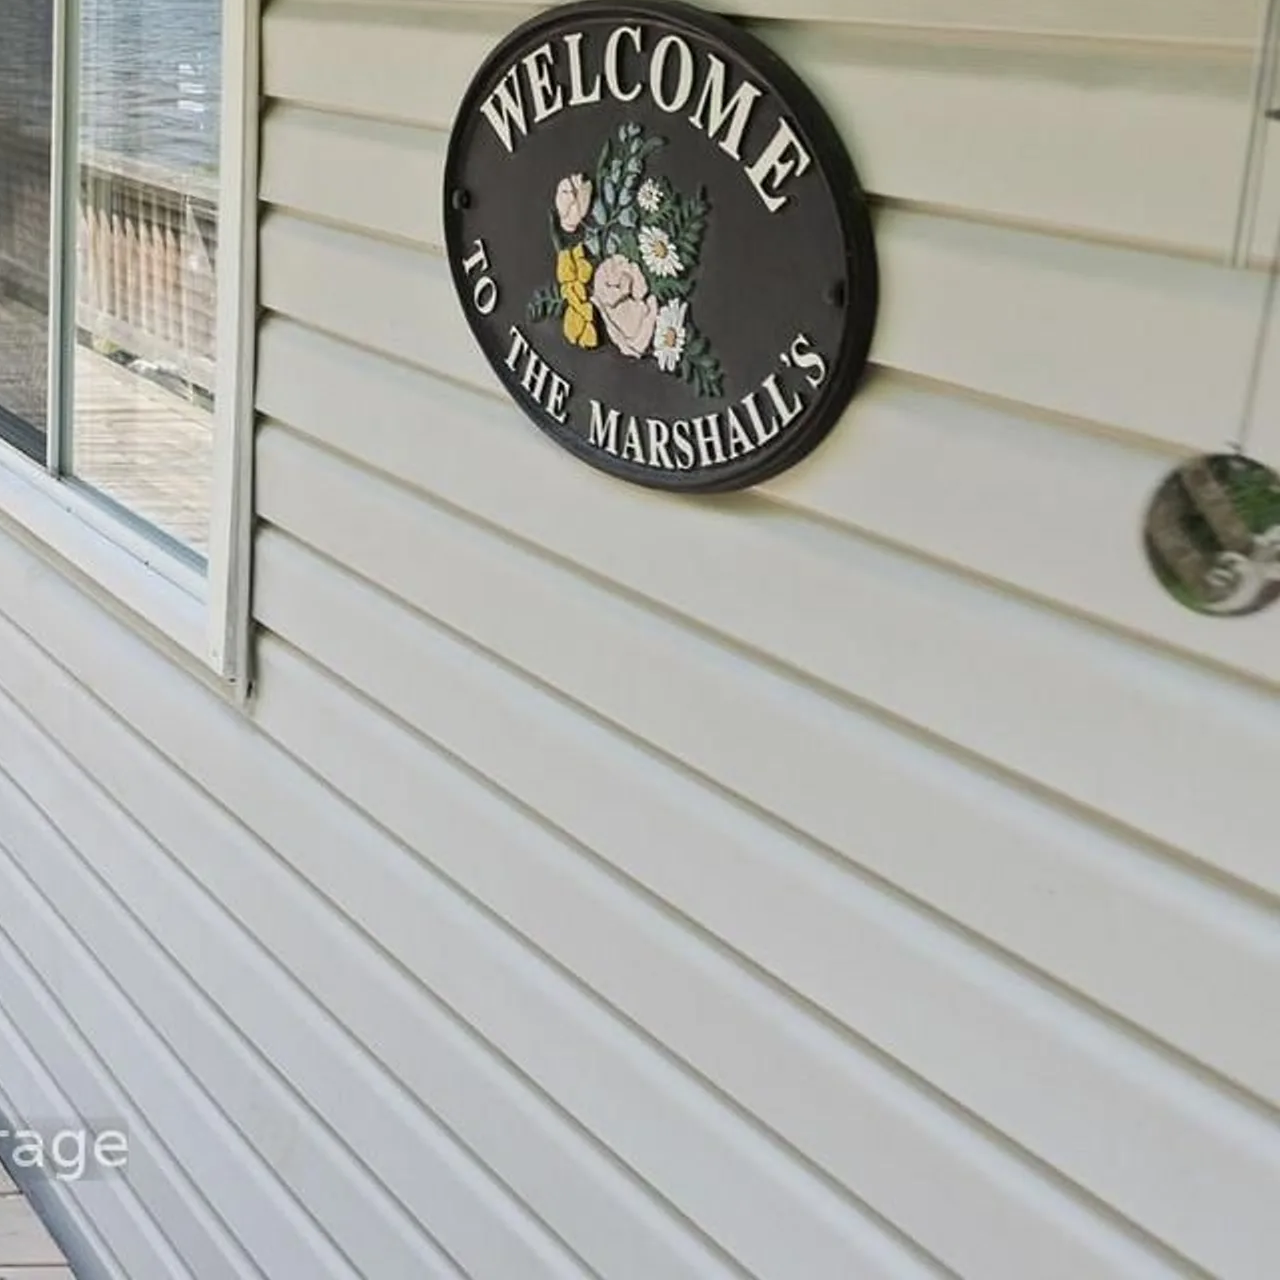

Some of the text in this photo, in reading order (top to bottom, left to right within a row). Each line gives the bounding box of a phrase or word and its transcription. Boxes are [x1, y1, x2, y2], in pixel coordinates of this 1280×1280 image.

[479, 24, 811, 214] WELCOME
[461, 238, 828, 470] TO THE MARSHALL'S
